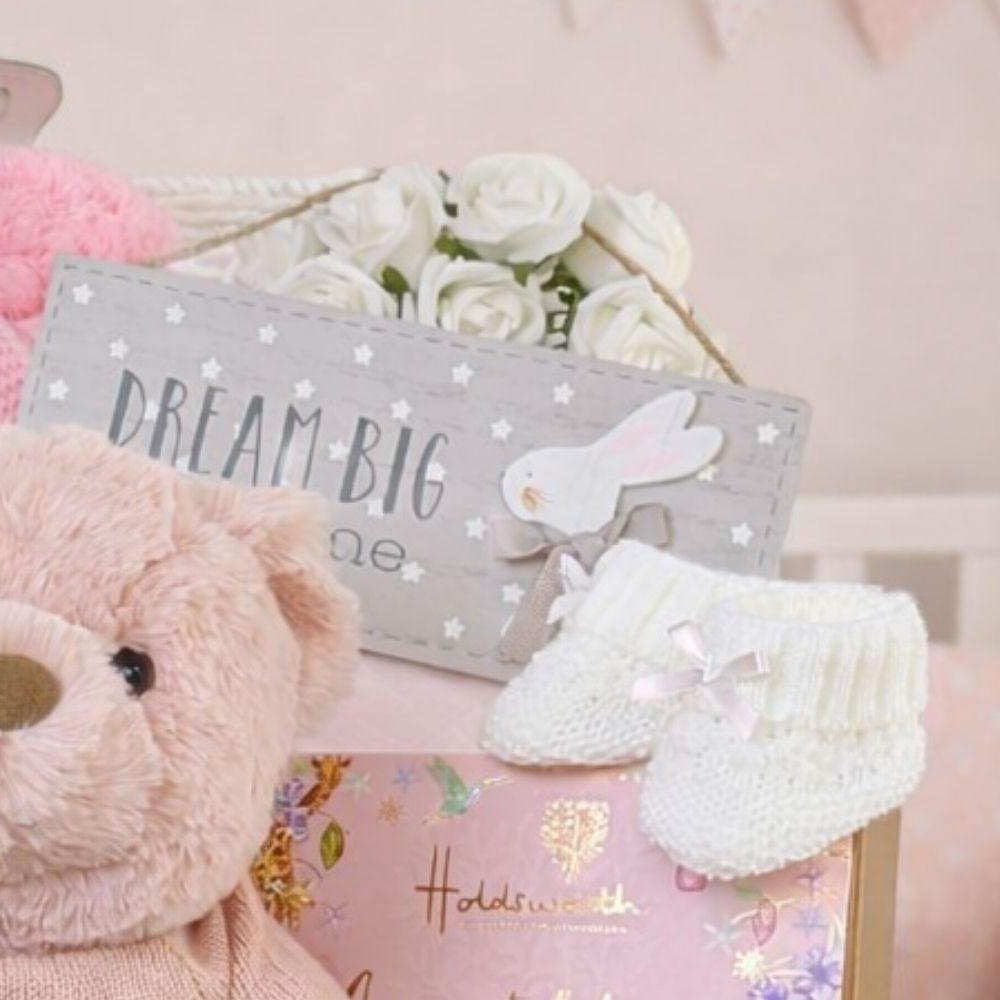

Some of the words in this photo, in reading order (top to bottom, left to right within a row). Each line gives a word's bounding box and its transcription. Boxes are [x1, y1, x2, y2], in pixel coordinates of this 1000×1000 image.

[108, 369, 322, 490] DREAM
[340, 416, 449, 521] BIG
[414, 844, 640, 934] Holdswoth
